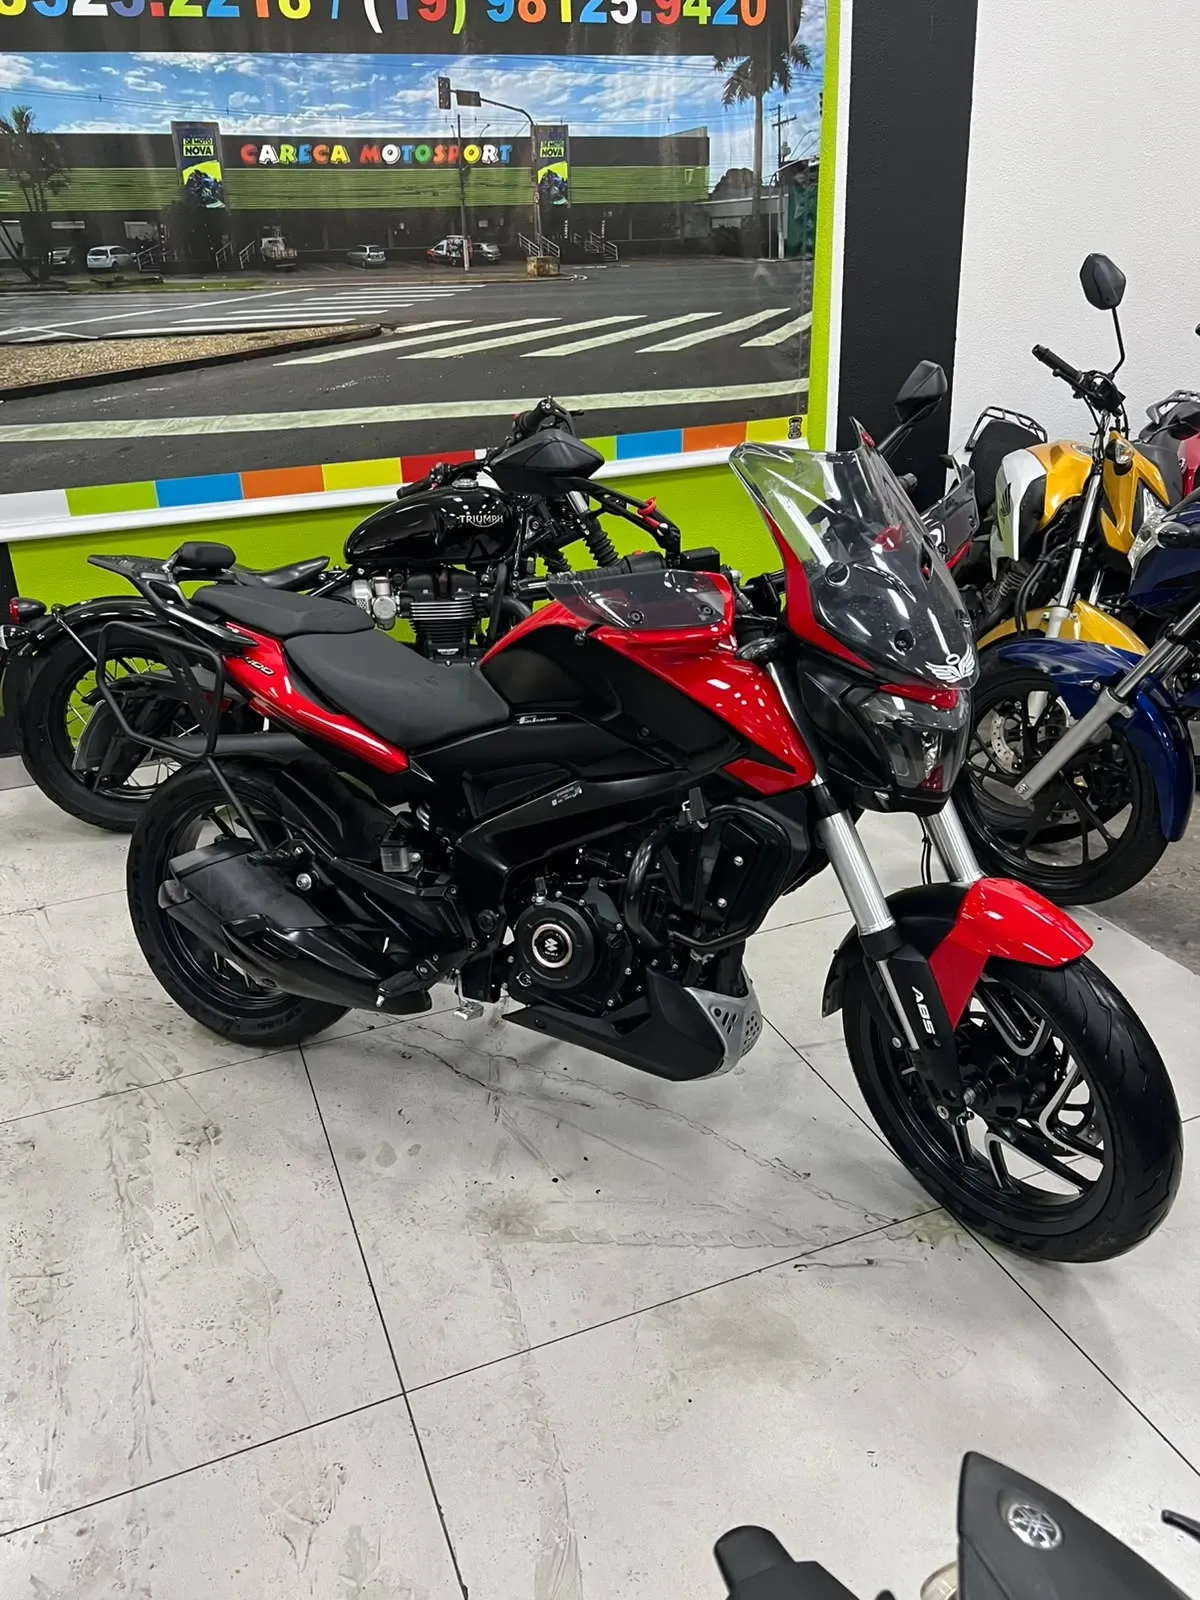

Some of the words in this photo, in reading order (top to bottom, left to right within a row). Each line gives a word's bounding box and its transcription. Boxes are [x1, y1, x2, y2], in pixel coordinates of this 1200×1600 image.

[185, 146, 212, 155] NOVA
[240, 143, 351, 165] CARECA
[359, 143, 512, 165] MOTOSPORT
[541, 148, 563, 156] NOVA
[459, 514, 504, 525] TRIUMPH
[911, 985, 936, 1035] ABS
